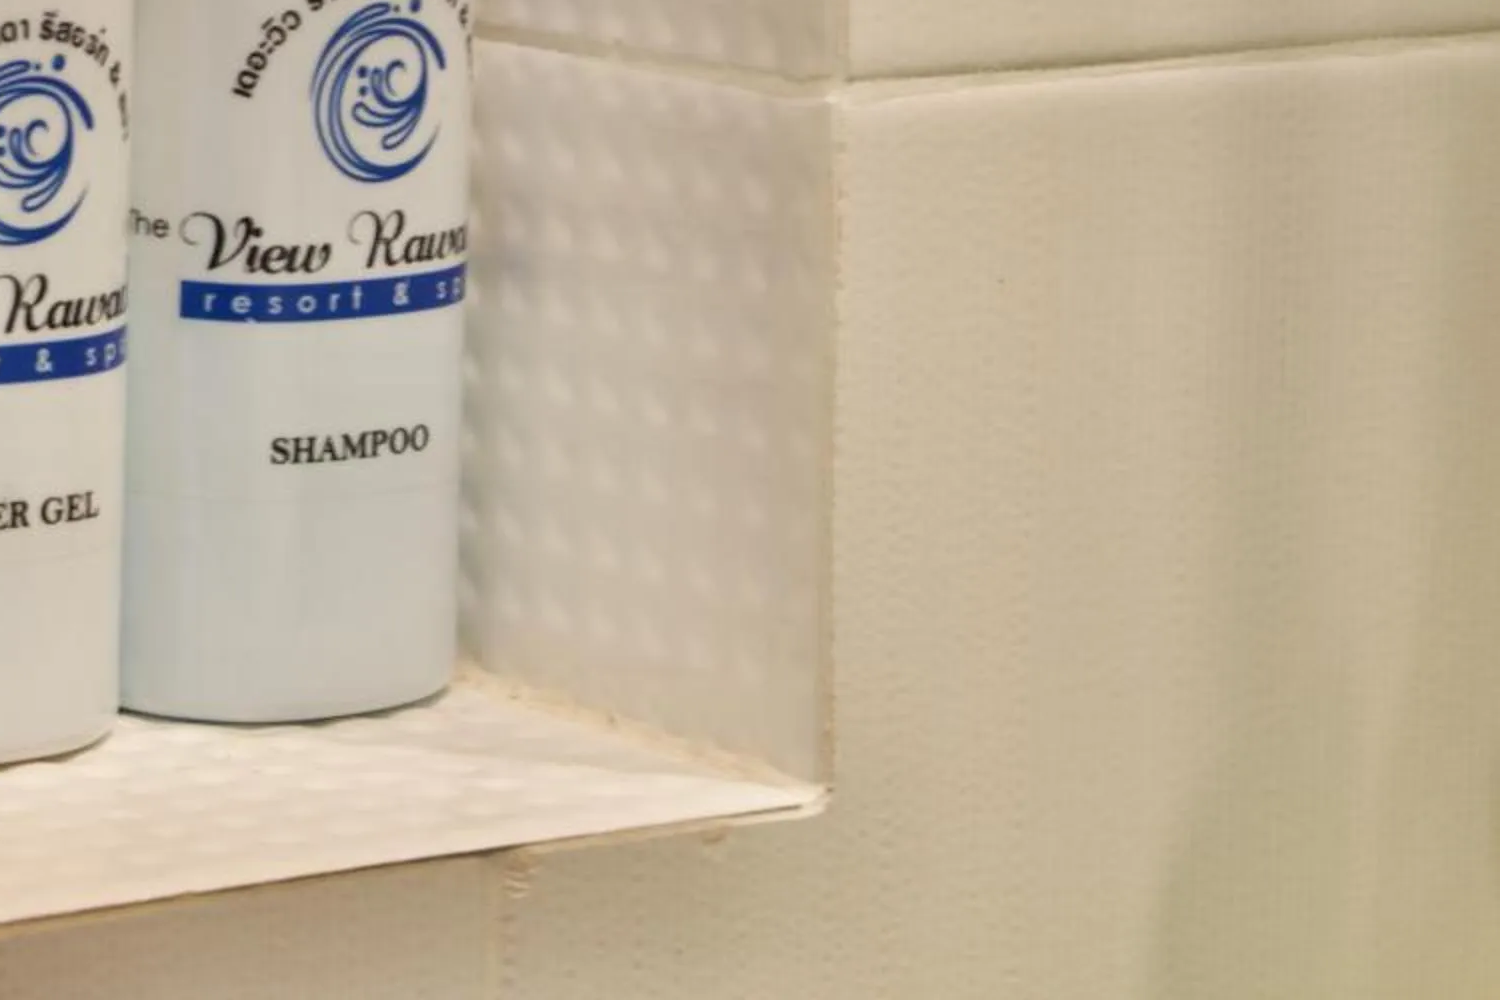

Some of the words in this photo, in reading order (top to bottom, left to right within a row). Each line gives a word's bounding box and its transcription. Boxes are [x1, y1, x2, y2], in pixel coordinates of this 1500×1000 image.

[178, 210, 333, 276] View
[203, 285, 363, 314] resort
[392, 281, 411, 307] &
[35, 347, 54, 374] &
[269, 424, 431, 466] SHAMPOO
[39, 491, 100, 526] GEL
